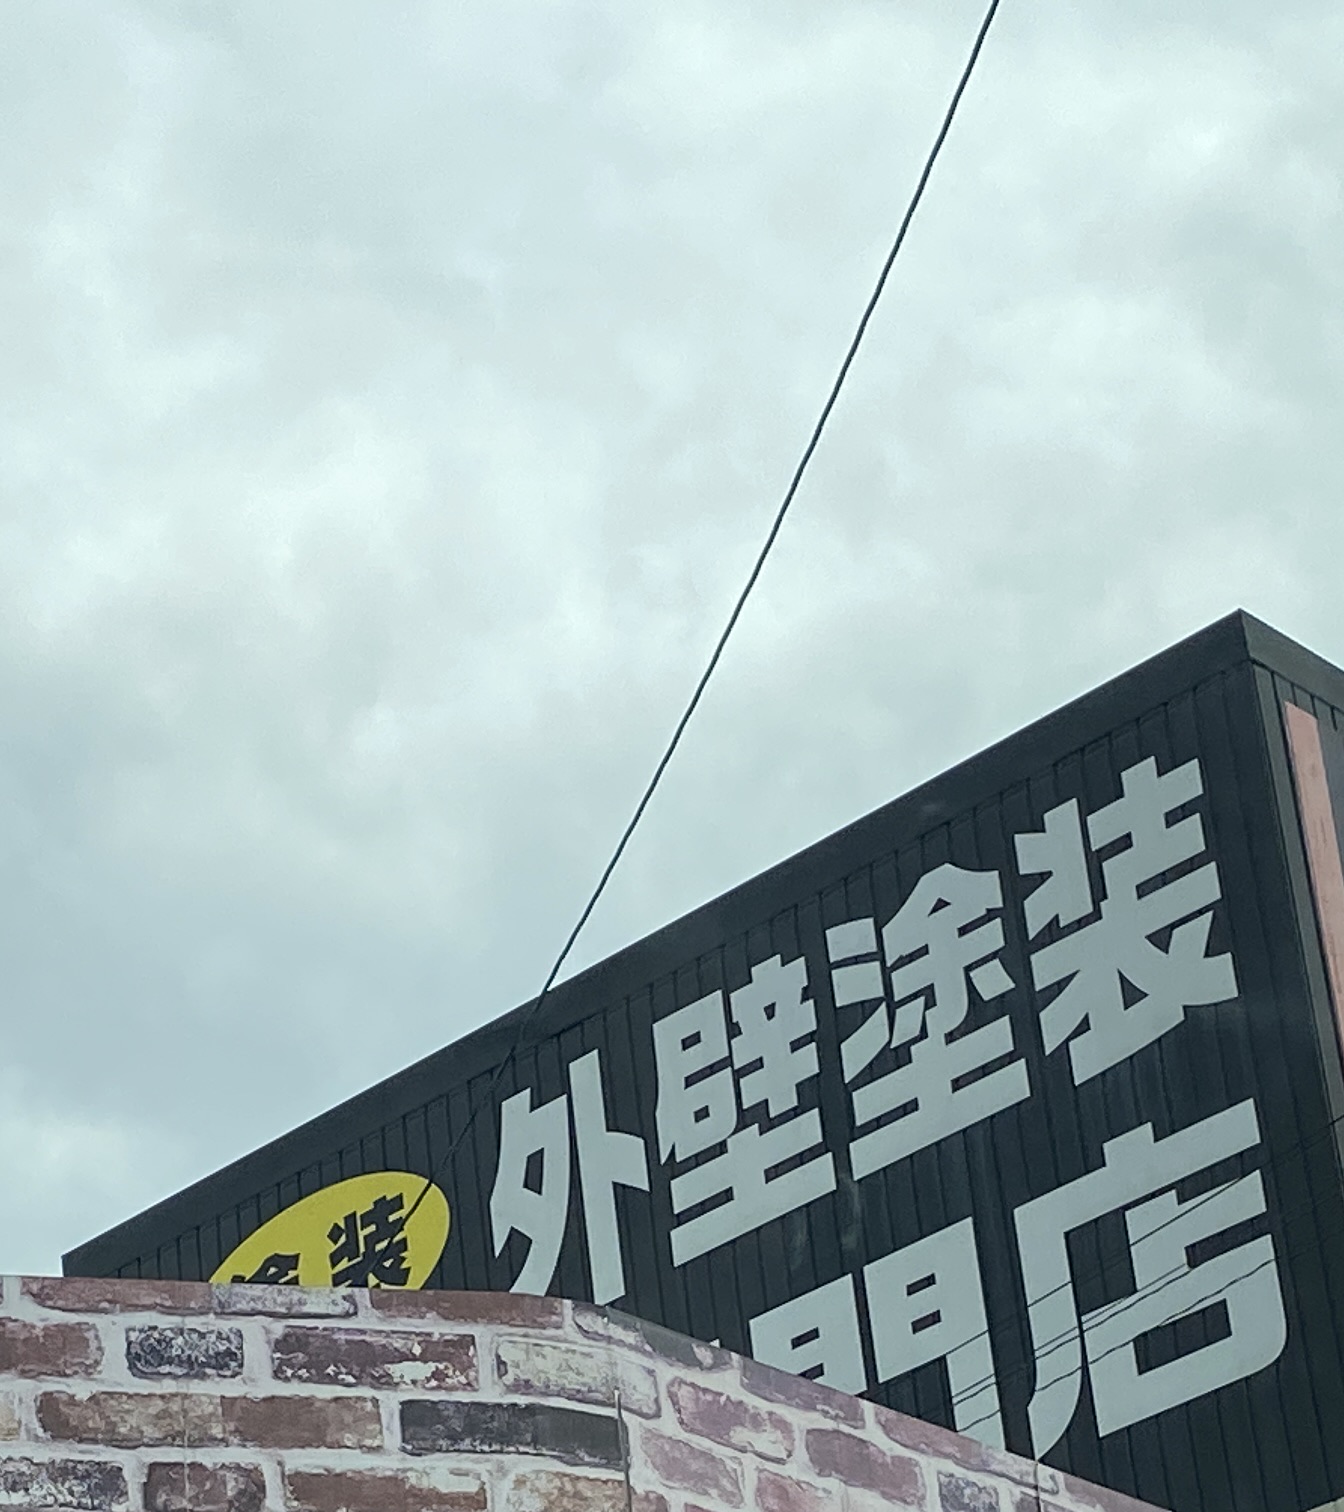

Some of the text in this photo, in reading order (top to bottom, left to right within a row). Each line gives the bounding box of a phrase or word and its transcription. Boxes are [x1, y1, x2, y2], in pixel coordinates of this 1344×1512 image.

[490, 756, 1239, 1305] 外壁塗装
[709, 1097, 1287, 1461] 門店
